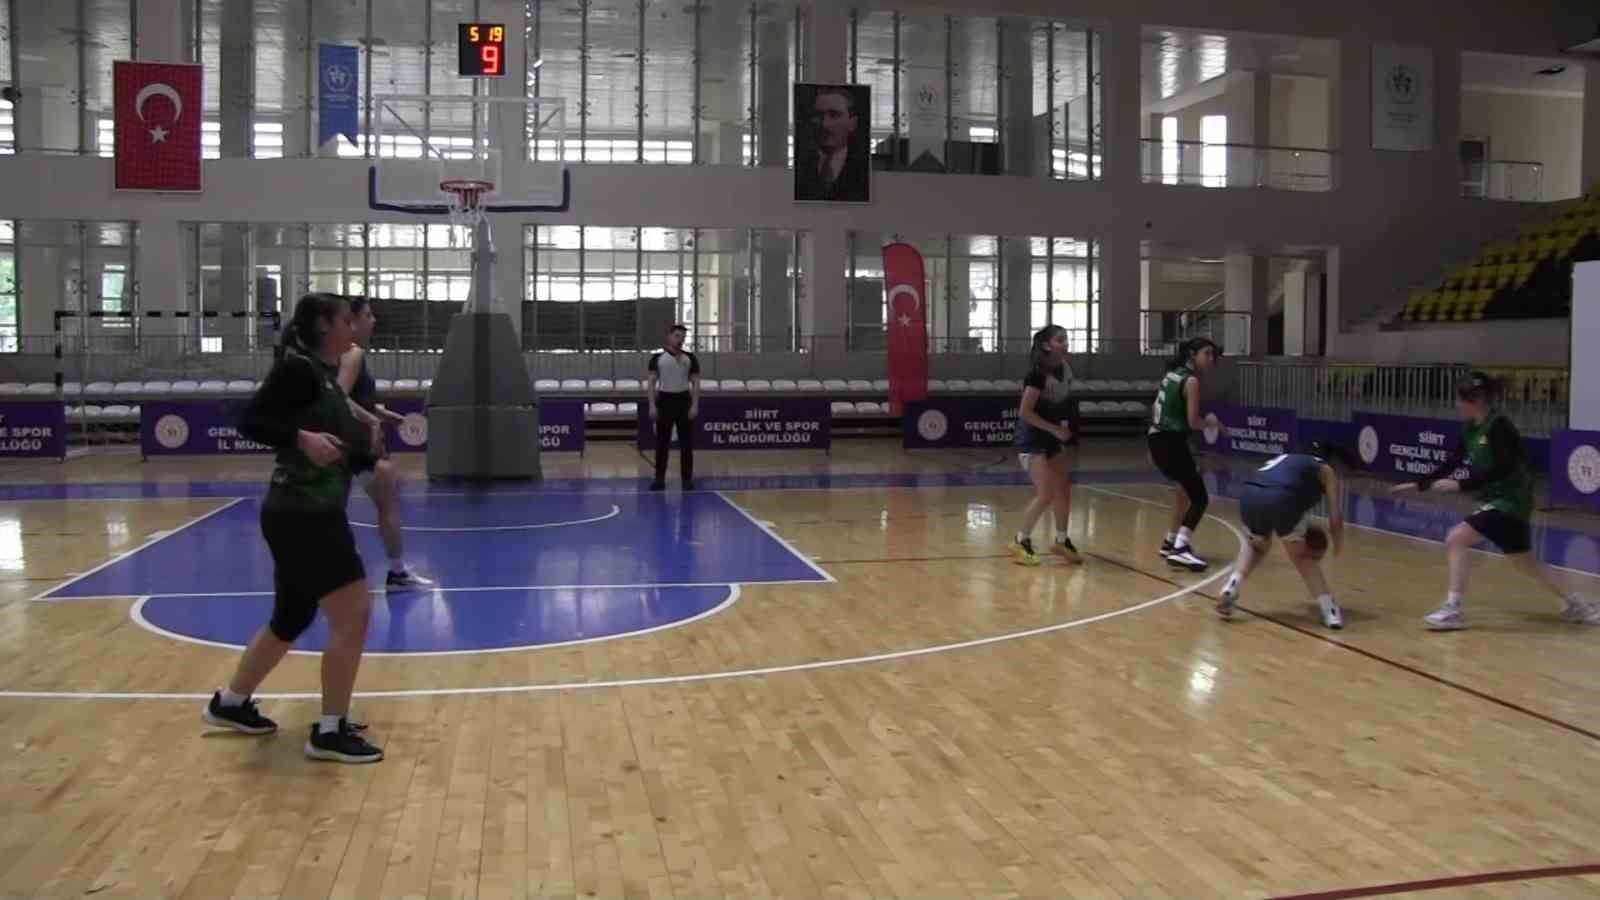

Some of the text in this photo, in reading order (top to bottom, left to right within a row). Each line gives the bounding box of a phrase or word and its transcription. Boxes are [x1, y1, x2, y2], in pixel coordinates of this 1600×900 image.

[470, 26, 503, 42] 5 19
[482, 46, 498, 73] 9
[704, 421, 819, 432] GENÇLİK VE SPOR
[12, 428, 52, 437] SPOR
[713, 432, 726, 443] İL
